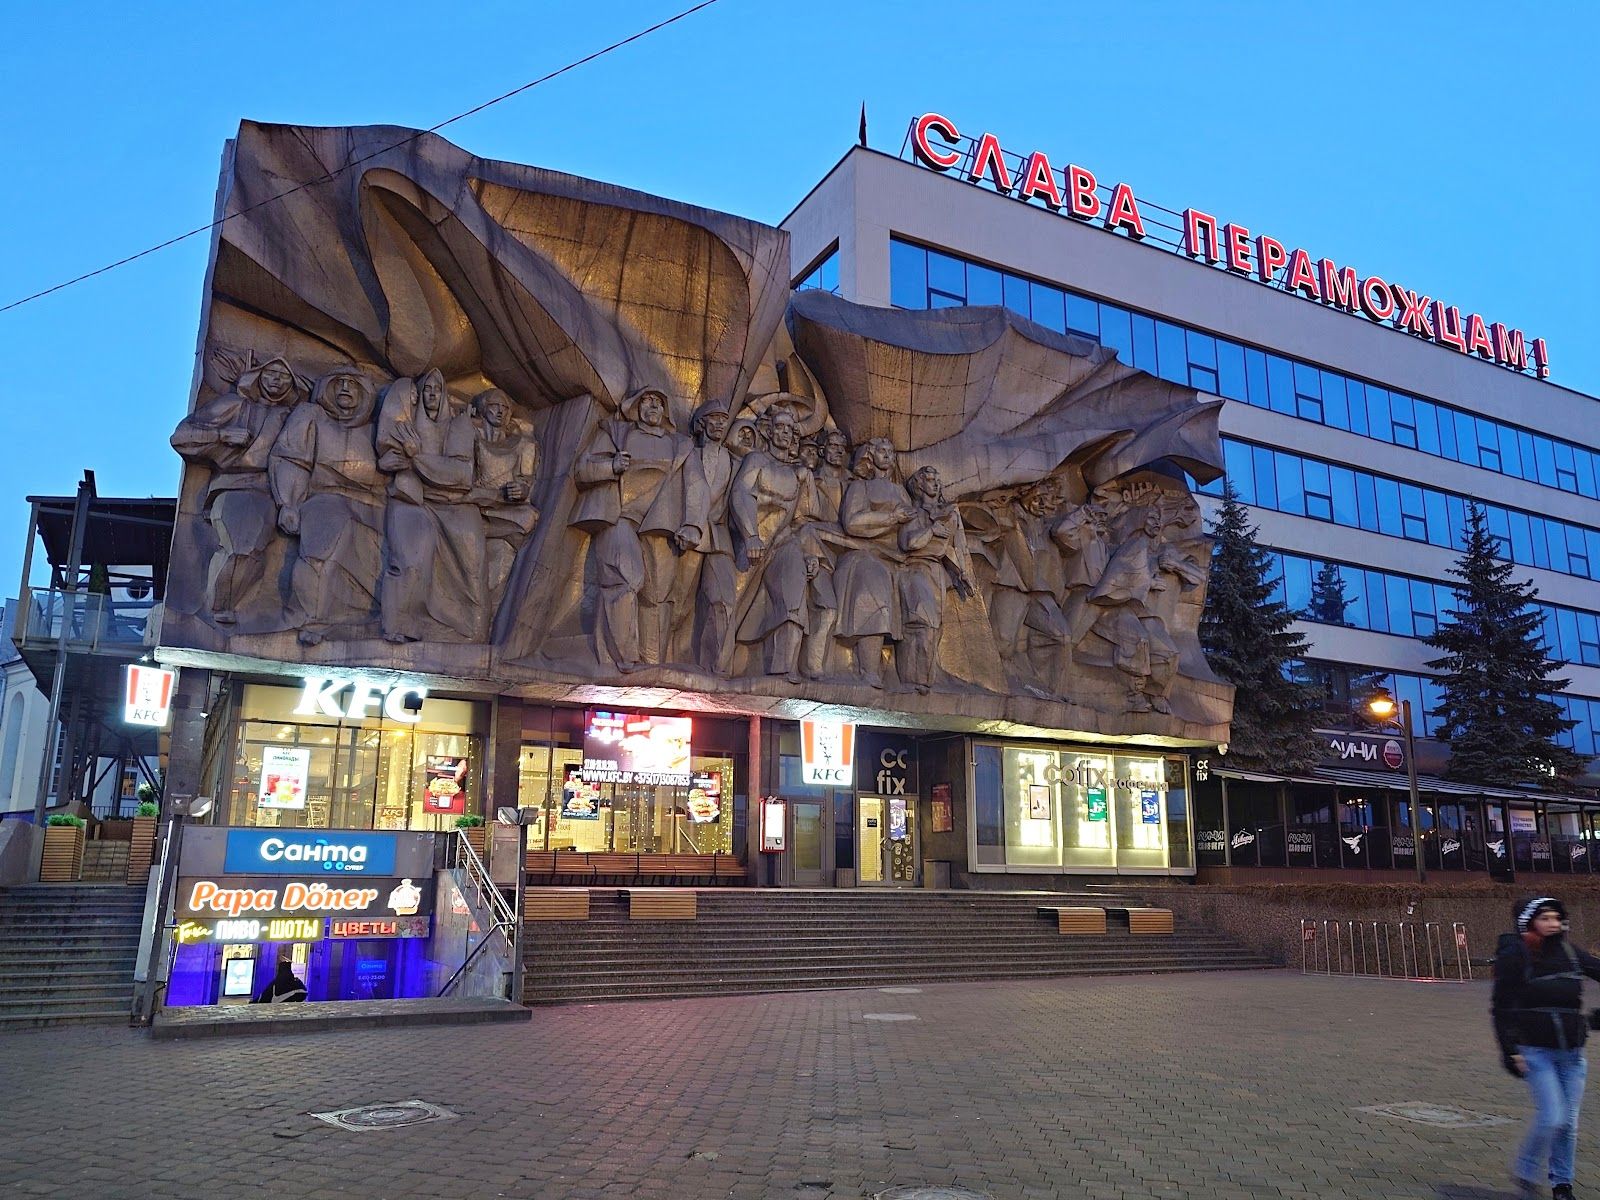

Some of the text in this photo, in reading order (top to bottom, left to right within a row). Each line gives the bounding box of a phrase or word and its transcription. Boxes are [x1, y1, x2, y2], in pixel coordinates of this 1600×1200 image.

[913, 112, 1549, 379] СЛАВА ПЕРАМОЖЦАМ!
[292, 676, 428, 723] KFC
[133, 708, 160, 722] KFC
[812, 768, 845, 781] KFC
[877, 770, 906, 795] fix
[1195, 770, 1208, 782] fix
[259, 838, 368, 863] Санта
[189, 881, 379, 918] Papa Döner
[334, 921, 398, 937] ЦВЕТЫ
